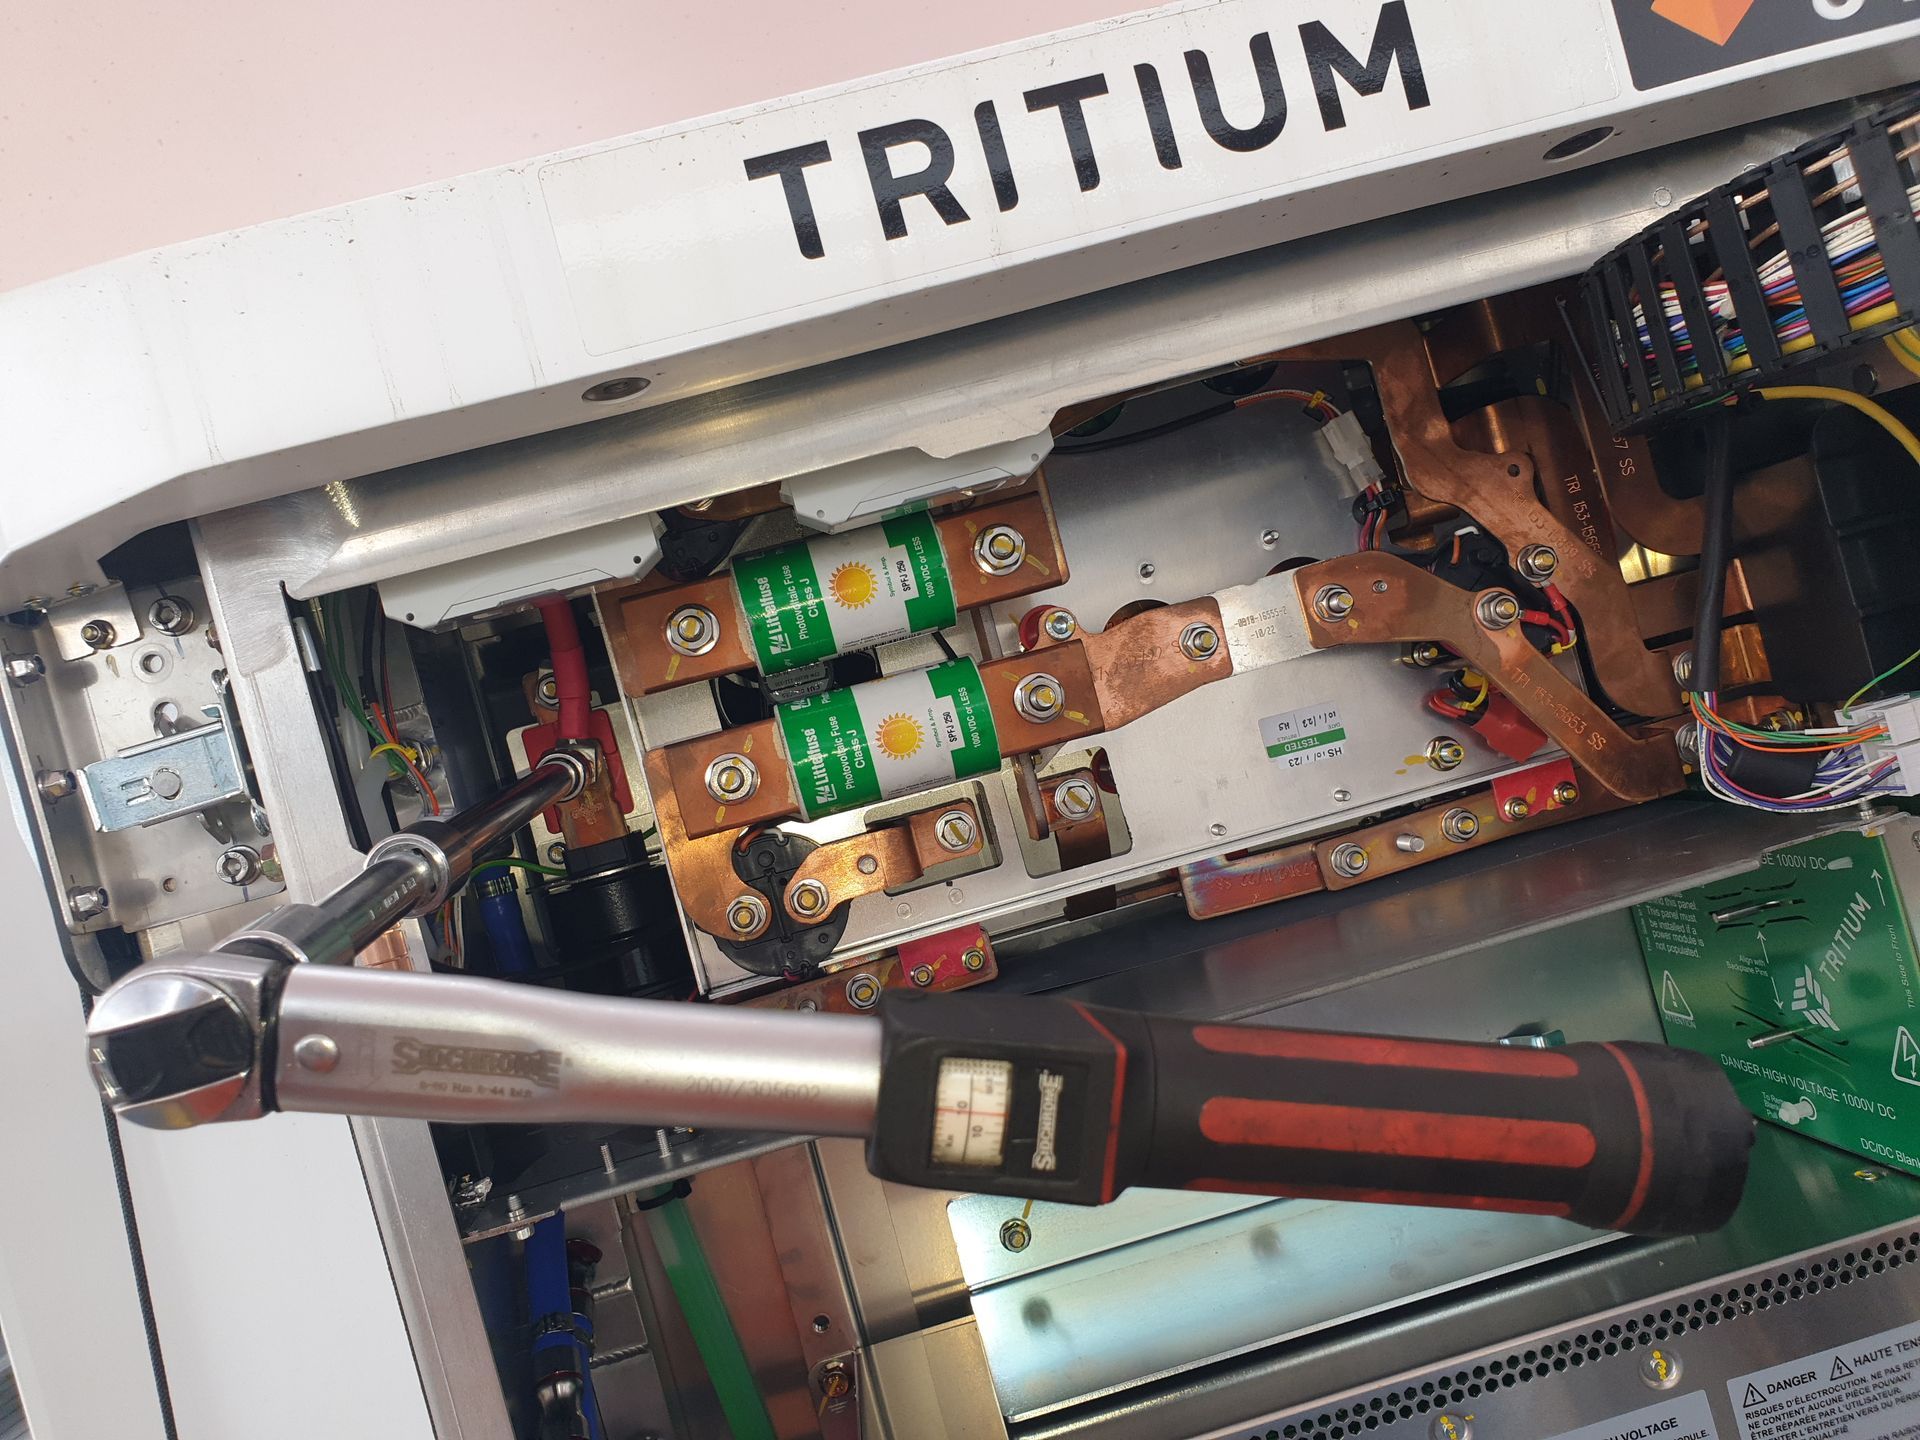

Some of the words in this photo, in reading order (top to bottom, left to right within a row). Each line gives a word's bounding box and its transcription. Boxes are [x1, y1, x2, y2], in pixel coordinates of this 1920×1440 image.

[743, 0, 1430, 259] TRITIUM
[912, 536, 924, 555] LESS
[782, 565, 795, 585] Fuse
[896, 560, 907, 573] 250
[920, 564, 932, 581] VDC
[925, 582, 936, 599] 1000
[757, 577, 783, 635] Littelfuse
[804, 586, 819, 618] Class
[958, 687, 970, 706] LESS
[828, 715, 841, 737] Fuse
[942, 711, 953, 724] 250
[966, 715, 977, 732] VDC
[970, 732, 981, 748] 1000
[1284, 737, 1319, 752] TESTED
[1587, 731, 1606, 751] SS
[804, 728, 830, 786] Littelfuse
[834, 737, 856, 790] Photovoltaic
[850, 738, 866, 769] Class
[1776, 854, 1807, 869] 1000V
[1809, 856, 1828, 870] DC
[1819, 891, 1872, 982] TRITIUM
[1720, 1053, 1762, 1077] DANGER
[1761, 1066, 1788, 1085] HIGH
[1789, 1076, 1839, 1102] VOLTAGE
[1842, 1092, 1874, 1113] 1000V
[1878, 1103, 1896, 1120] DC
[1860, 1137, 1894, 1159] DC/DC
[1767, 1371, 1818, 1395] DANGER
[1853, 1346, 1893, 1367] HAUTE
[1745, 1402, 1785, 1420] RISQUES
[1870, 1371, 1883, 1380] NE
[1884, 1364, 1901, 1375] PAS
[1748, 1421, 1761, 1431] NE
[1762, 1406, 1806, 1427] CONTIENT
[1807, 1394, 1845, 1412] AUCUNE
[1872, 1372, 1912, 1391] POUVANT
[1855, 1404, 1879, 1417] VERS
[1880, 1400, 1893, 1410] DU
[1620, 1417, 1679, 1440] VOLTAGE
[1750, 1426, 1775, 1440] ÊTRE
[1775, 1413, 1817, 1434] RÉPARÉE
[1818, 1408, 1837, 1420] PAR
